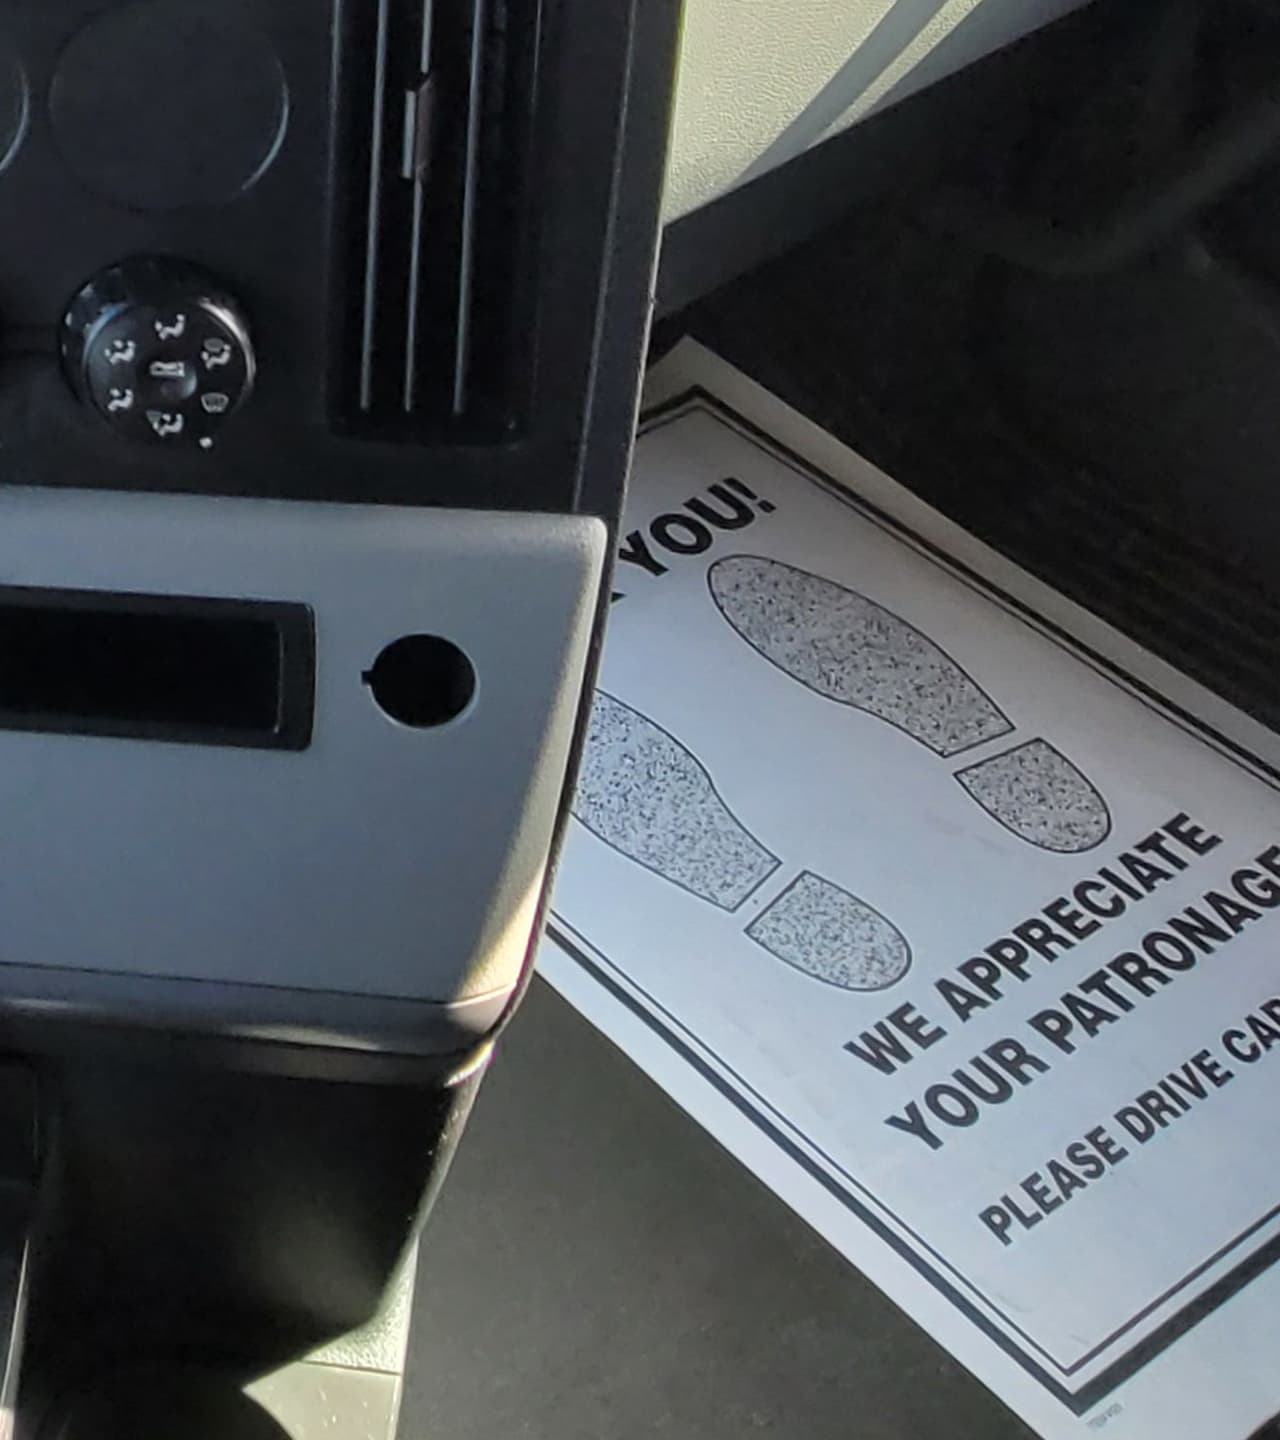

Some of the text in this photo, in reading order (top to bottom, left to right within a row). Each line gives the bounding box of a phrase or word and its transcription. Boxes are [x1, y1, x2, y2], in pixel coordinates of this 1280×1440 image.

[618, 477, 777, 577] YOU!
[843, 812, 1224, 1076] WE APPRECIATE
[884, 1037, 1051, 1151] YOUR
[978, 1125, 1130, 1246] PLEASE
[1114, 1049, 1235, 1144] DRIVE
